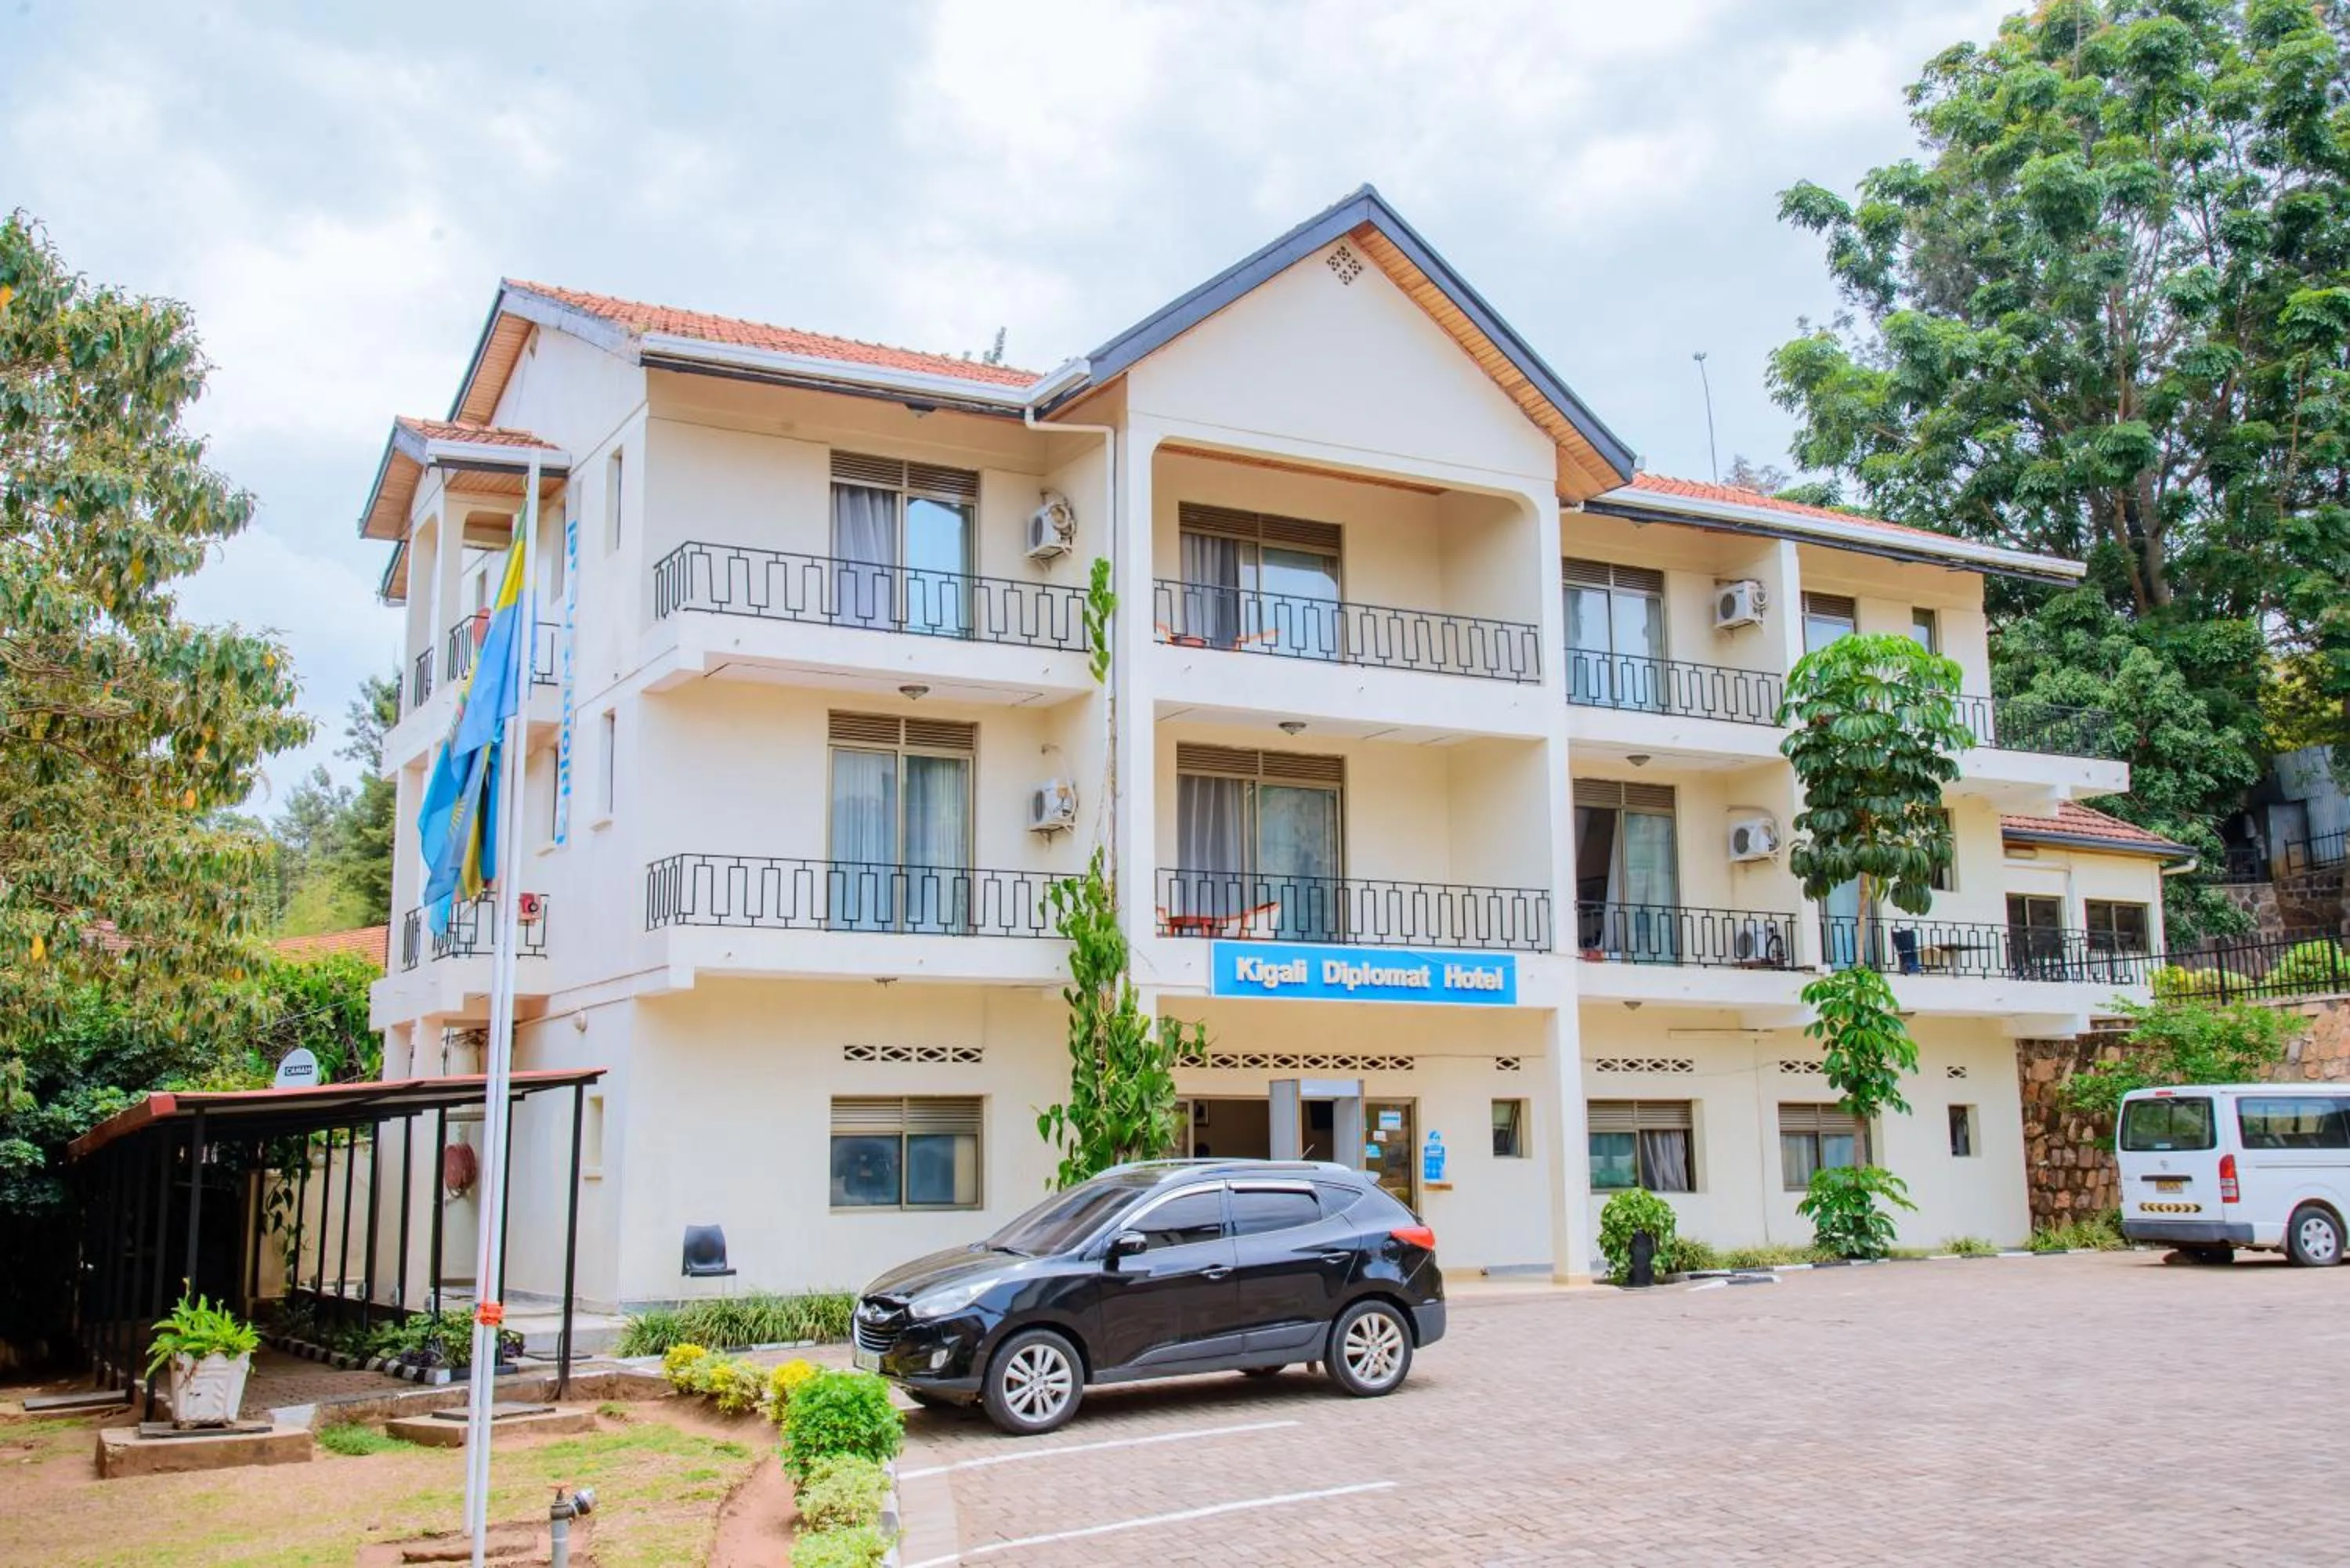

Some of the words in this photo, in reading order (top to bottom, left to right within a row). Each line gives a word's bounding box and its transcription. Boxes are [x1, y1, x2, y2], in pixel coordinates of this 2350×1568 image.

[1235, 956, 1307, 988] Kigali
[1321, 960, 1430, 991] Diplomat
[1444, 963, 1504, 991] Hotel
